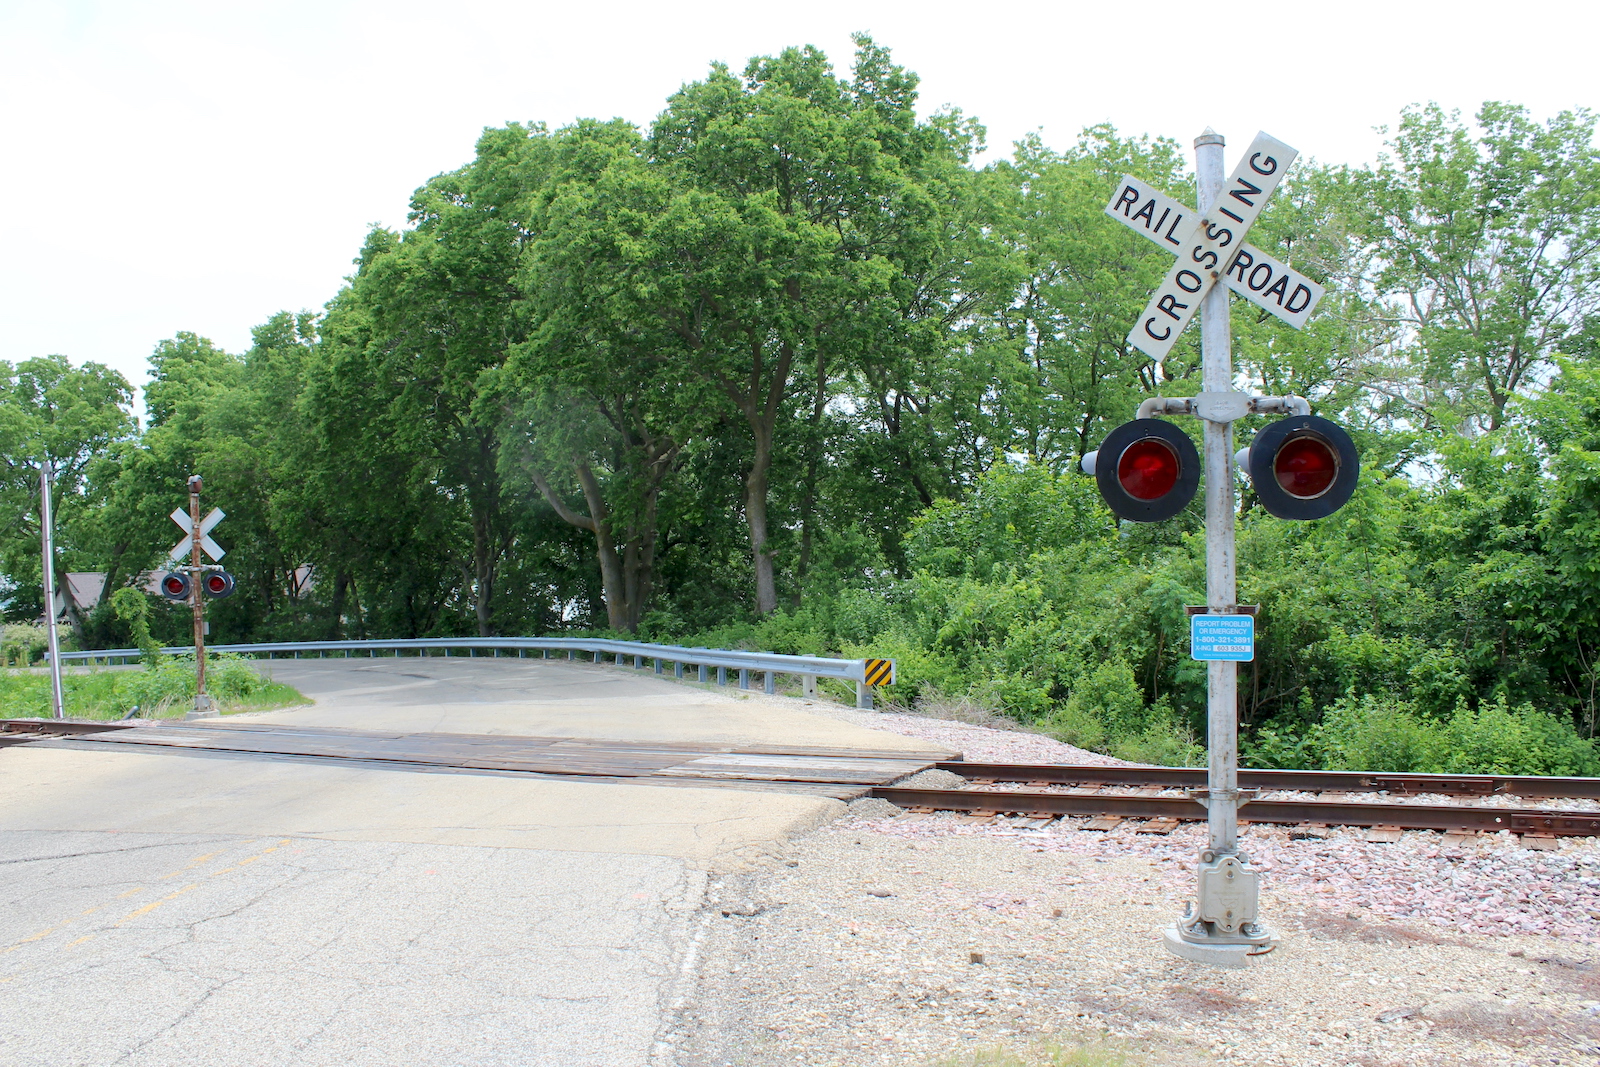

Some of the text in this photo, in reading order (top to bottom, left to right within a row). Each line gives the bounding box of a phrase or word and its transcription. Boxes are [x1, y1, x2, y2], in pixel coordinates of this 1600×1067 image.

[1113, 185, 1312, 314] RAIL ROAD
[1145, 152, 1277, 342] CROSSING
